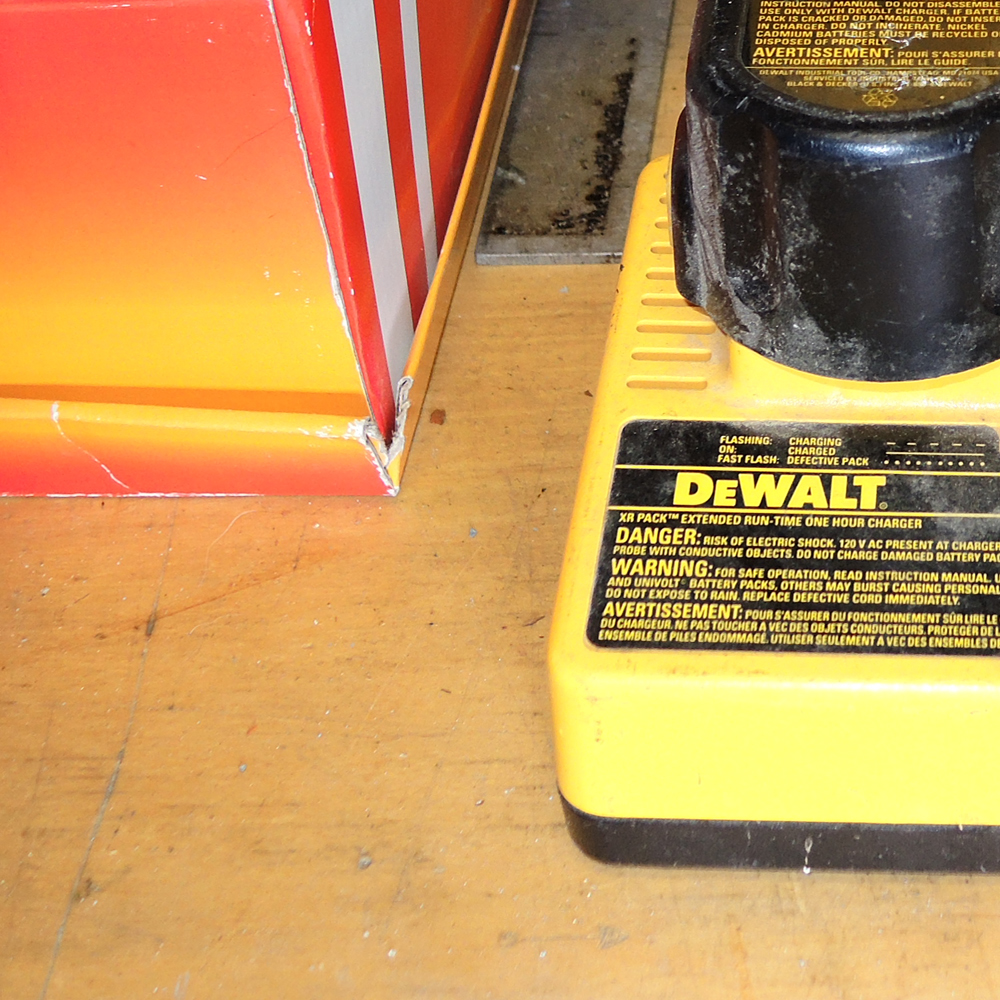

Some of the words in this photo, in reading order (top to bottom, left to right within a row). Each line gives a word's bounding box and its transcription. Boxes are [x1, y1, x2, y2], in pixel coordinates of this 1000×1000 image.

[885, 0, 901, 9] DO
[815, 7, 846, 16] WITH
[846, 7, 893, 16] DEWALT
[800, 15, 849, 23] CRACKED
[850, 15, 867, 23] OR
[815, 30, 875, 38] BATTERIES
[878, 30, 913, 39] MUST
[753, 47, 894, 58] AVERTISSEMENT:
[897, 50, 928, 58] POUR
[719, 435, 773, 446] FLASHING:
[788, 436, 842, 446] CHARGING
[718, 445, 738, 453] ON:
[787, 446, 836, 456] CHARGED
[717, 454, 743, 463] FAST
[744, 454, 780, 464] FLASH:
[786, 456, 839, 465] DEFECTIVE
[841, 456, 869, 466] PACK
[618, 512, 635, 522] XR
[680, 513, 741, 525] EXTENDED
[743, 515, 802, 526] RUN-TIME
[804, 515, 829, 527] ONE
[831, 516, 865, 527] HOUR
[867, 517, 922, 528] CHARGER
[615, 526, 702, 544] DANGER:
[703, 535, 728, 545] RISK
[730, 536, 744, 546] OF
[745, 536, 795, 547] ELECTRIC
[839, 538, 856, 548] 120
[858, 538, 866, 549] V
[867, 538, 883, 549] AC
[885, 539, 933, 550] PRESENT
[935, 539, 950, 550] AT
[612, 545, 647, 555] PROBE
[648, 545, 677, 555] WITH
[678, 546, 743, 557] CONDUCTIVE
[796, 548, 811, 559] DO
[813, 549, 835, 559] NOT
[836, 549, 878, 560] CHARGE
[880, 550, 934, 561] DAMAGED
[935, 551, 981, 562] BATTERY
[611, 558, 714, 578] WARNING:
[714, 567, 736, 577] FOR
[738, 568, 764, 578] SAFE
[833, 569, 863, 580] READ
[865, 570, 939, 581] INSTRUCTION
[606, 577, 632, 589] AND
[688, 578, 737, 591] BATTERY
[780, 580, 823, 591] OTHERS
[825, 581, 851, 591] MAY
[853, 581, 890, 592] BURST
[891, 582, 941, 593] CAUSING
[943, 583, 1000, 594] PERSONAL
[604, 588, 622, 598] DO
[623, 588, 647, 598] NOT
[648, 589, 691, 599] EXPOSE
[693, 589, 708, 600] TO
[742, 591, 790, 602] REPLACE
[792, 592, 849, 603] DEFECTIVE
[852, 593, 882, 604] CORD
[602, 602, 744, 621] AVERTISSEMENT:
